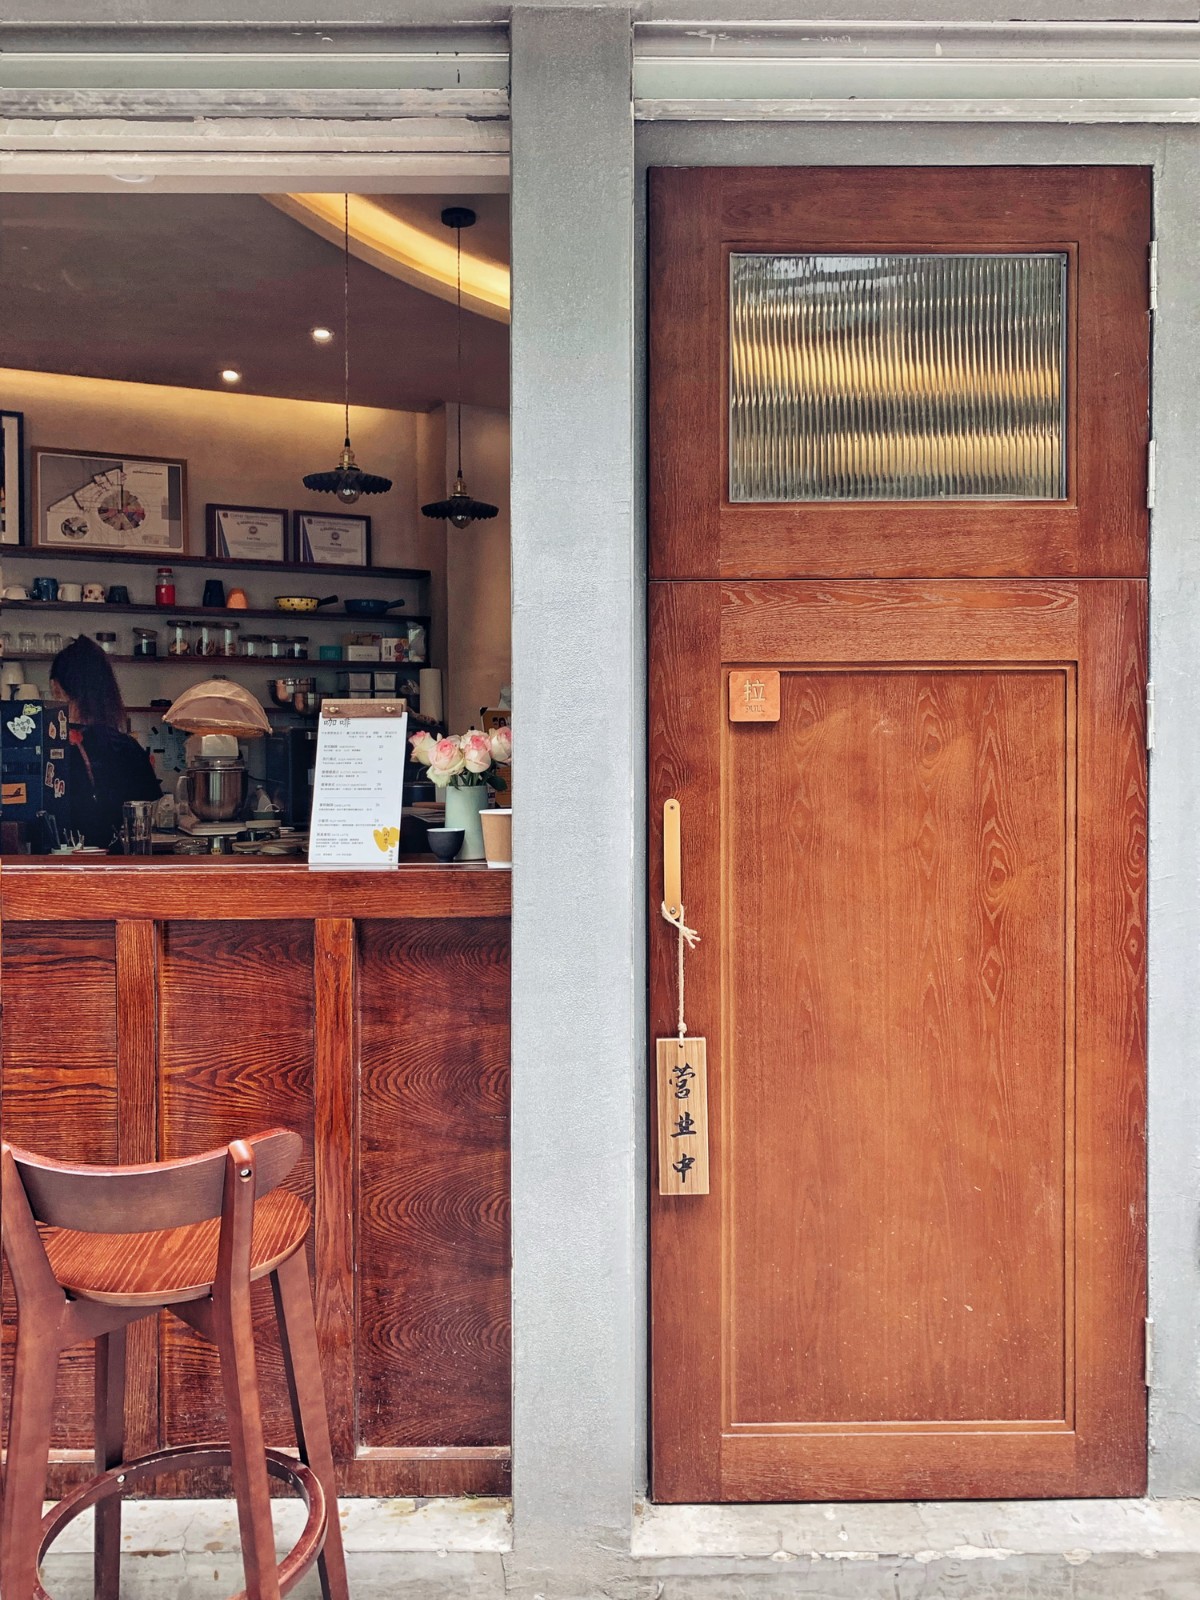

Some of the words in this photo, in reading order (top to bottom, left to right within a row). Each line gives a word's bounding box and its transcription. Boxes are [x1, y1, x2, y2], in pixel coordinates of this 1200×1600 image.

[744, 679, 766, 702] 拉
[745, 705, 766, 713] PULL
[669, 1063, 697, 1183] 营业中
